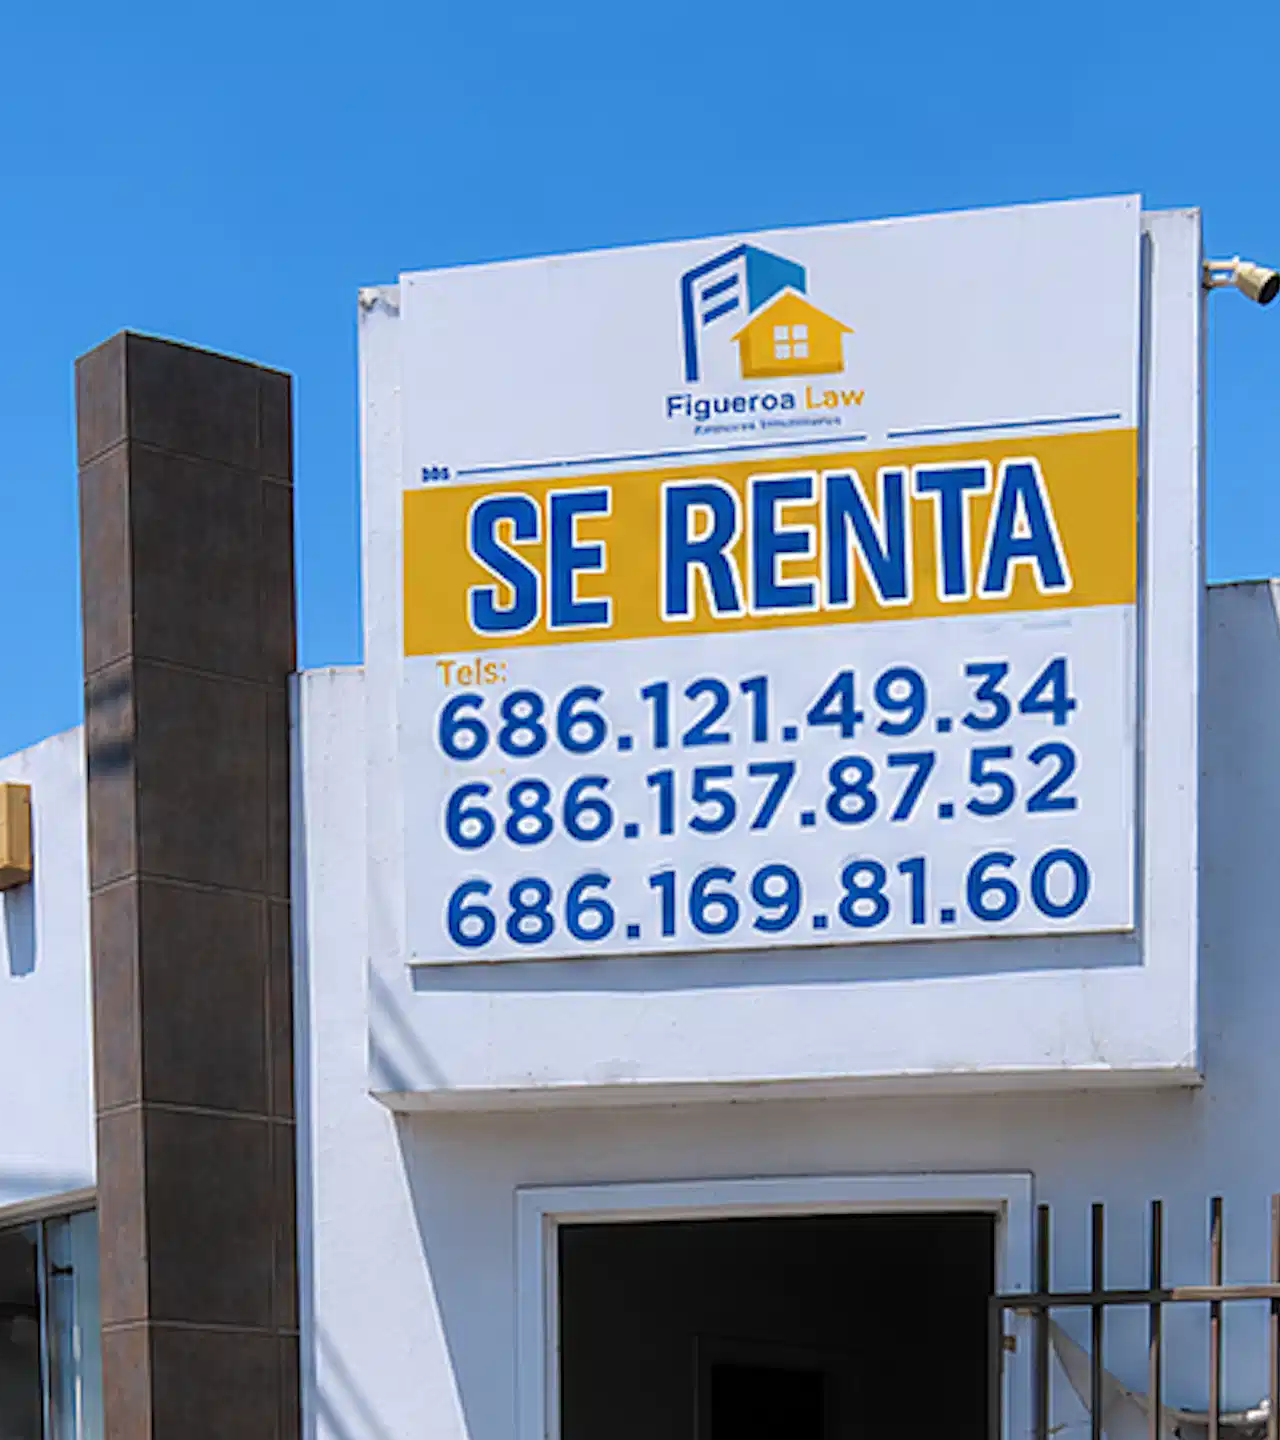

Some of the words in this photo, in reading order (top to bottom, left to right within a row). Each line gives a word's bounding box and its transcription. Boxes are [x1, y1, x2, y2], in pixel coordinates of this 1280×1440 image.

[666, 393, 796, 422] Figueroa
[805, 385, 865, 410] Law
[470, 489, 610, 634] SE
[664, 463, 1068, 616] RENTA
[436, 657, 508, 687] Tels:
[438, 656, 1078, 762] 686.121.49.34
[444, 742, 1079, 851] 686.157.87.52
[446, 847, 1092, 950] 686.169.81.60
